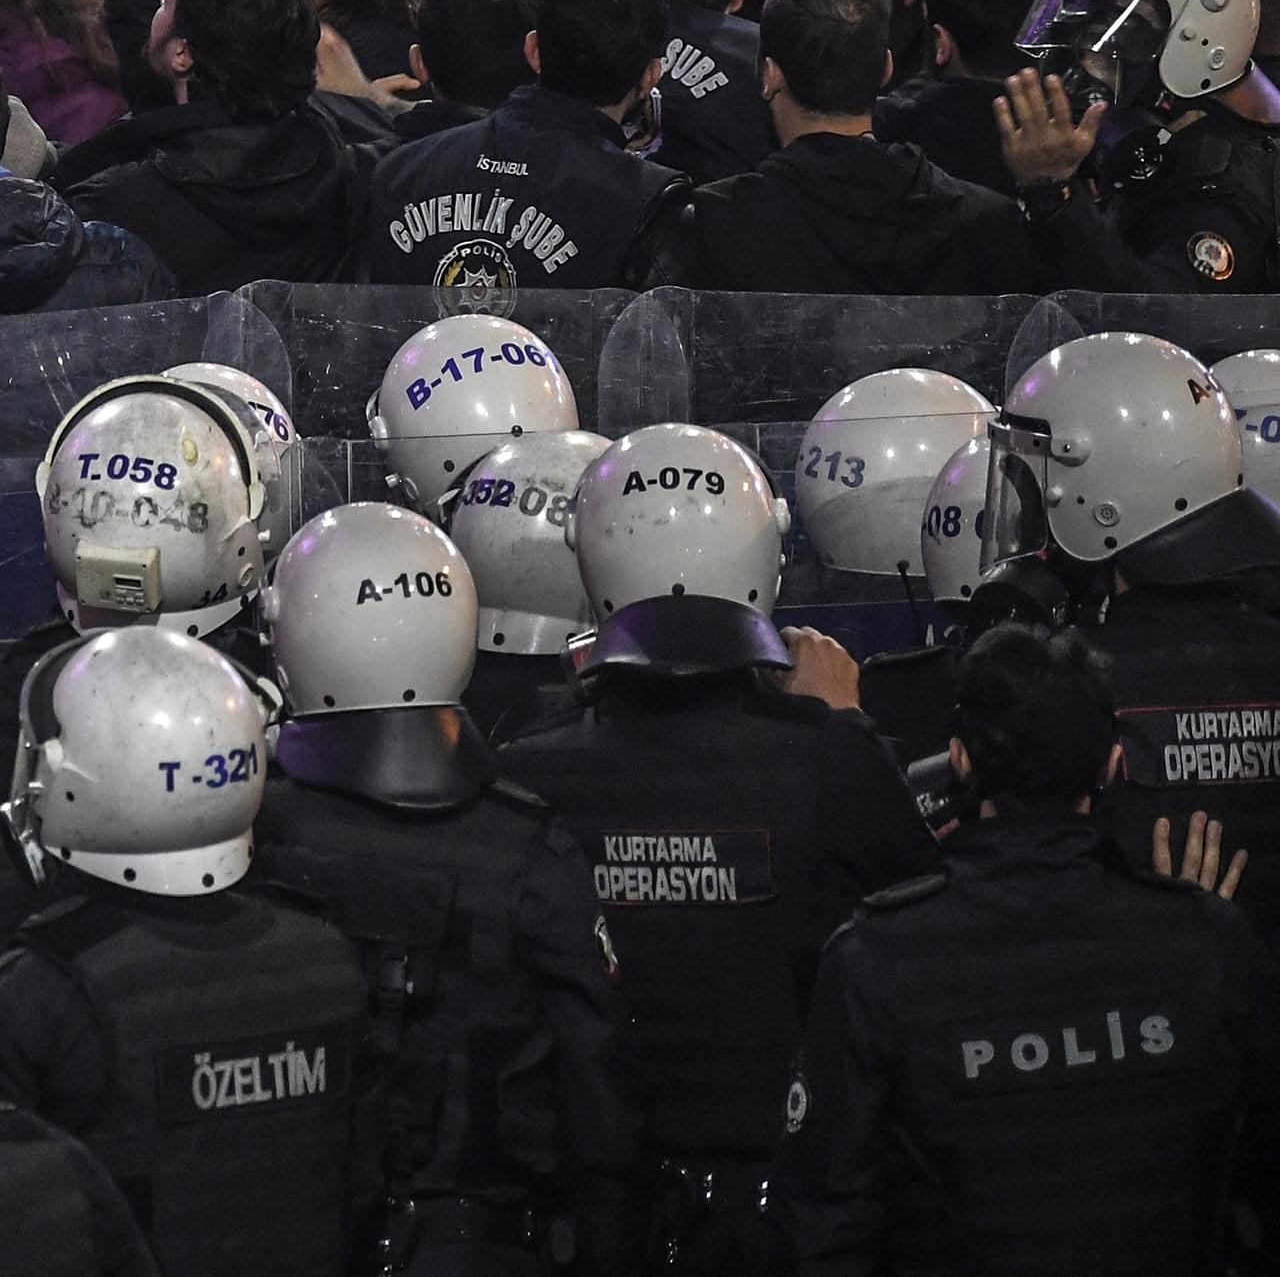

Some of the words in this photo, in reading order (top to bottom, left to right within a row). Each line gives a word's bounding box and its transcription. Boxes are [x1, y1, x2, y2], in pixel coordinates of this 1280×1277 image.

[476, 154, 529, 176] İSTANBUL
[390, 188, 515, 254] GÜVENLİK
[505, 205, 579, 274] ŞUBE
[621, 467, 726, 498] A-079
[356, 571, 453, 605] A-106
[159, 742, 259, 794] T-321
[603, 835, 718, 864] KURTARMA
[592, 864, 738, 904] OPERASYON
